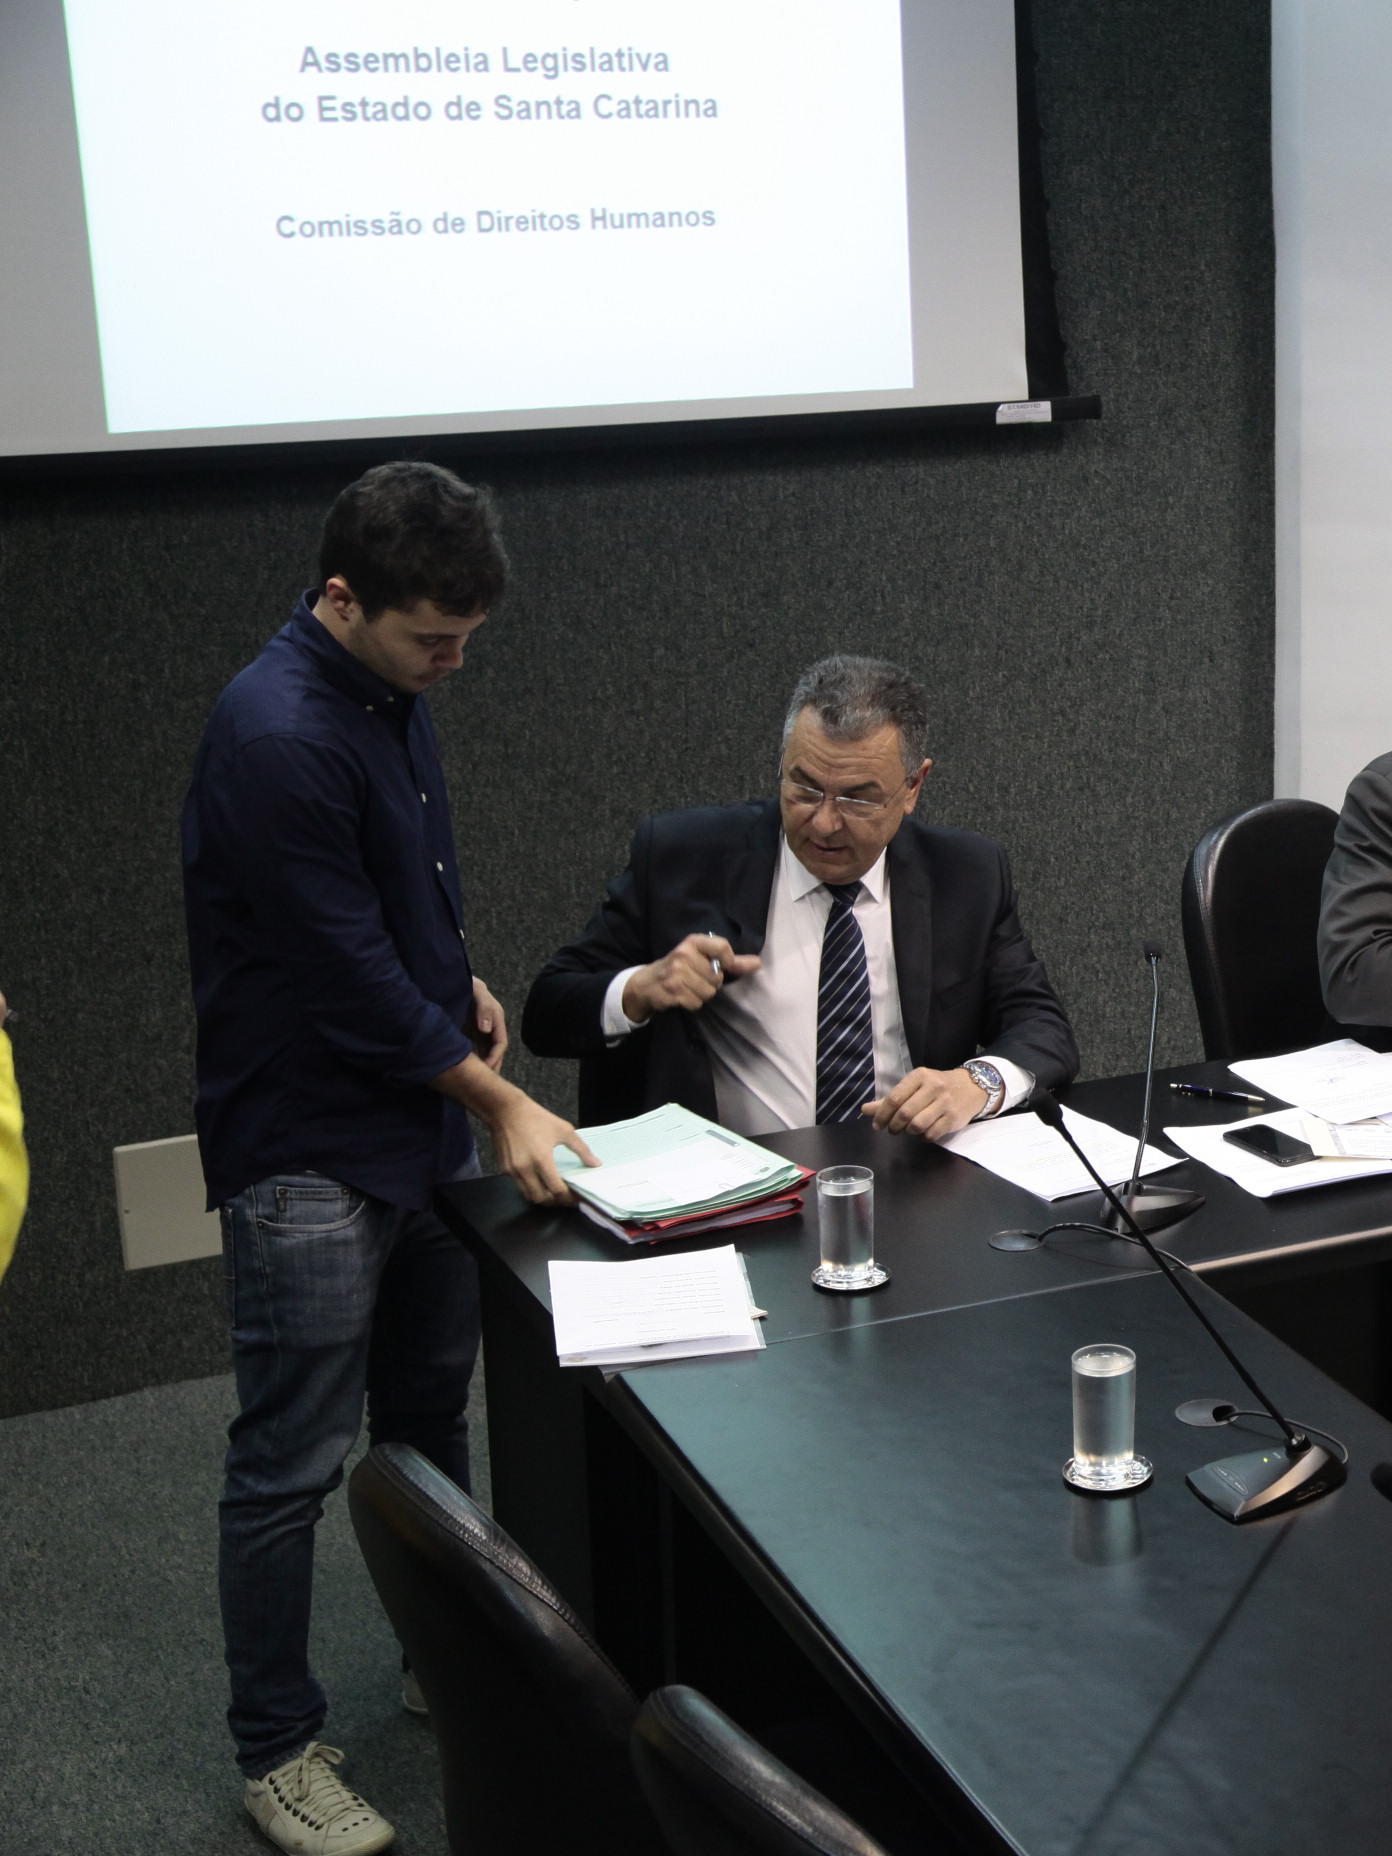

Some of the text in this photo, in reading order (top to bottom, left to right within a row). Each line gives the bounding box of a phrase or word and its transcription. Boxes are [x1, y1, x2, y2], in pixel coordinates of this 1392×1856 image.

[299, 45, 670, 80] Assembleia Legislativa
[261, 93, 718, 123] do Estado de Santa Catarina
[276, 208, 716, 238] Comissão de Direitos Humanos
